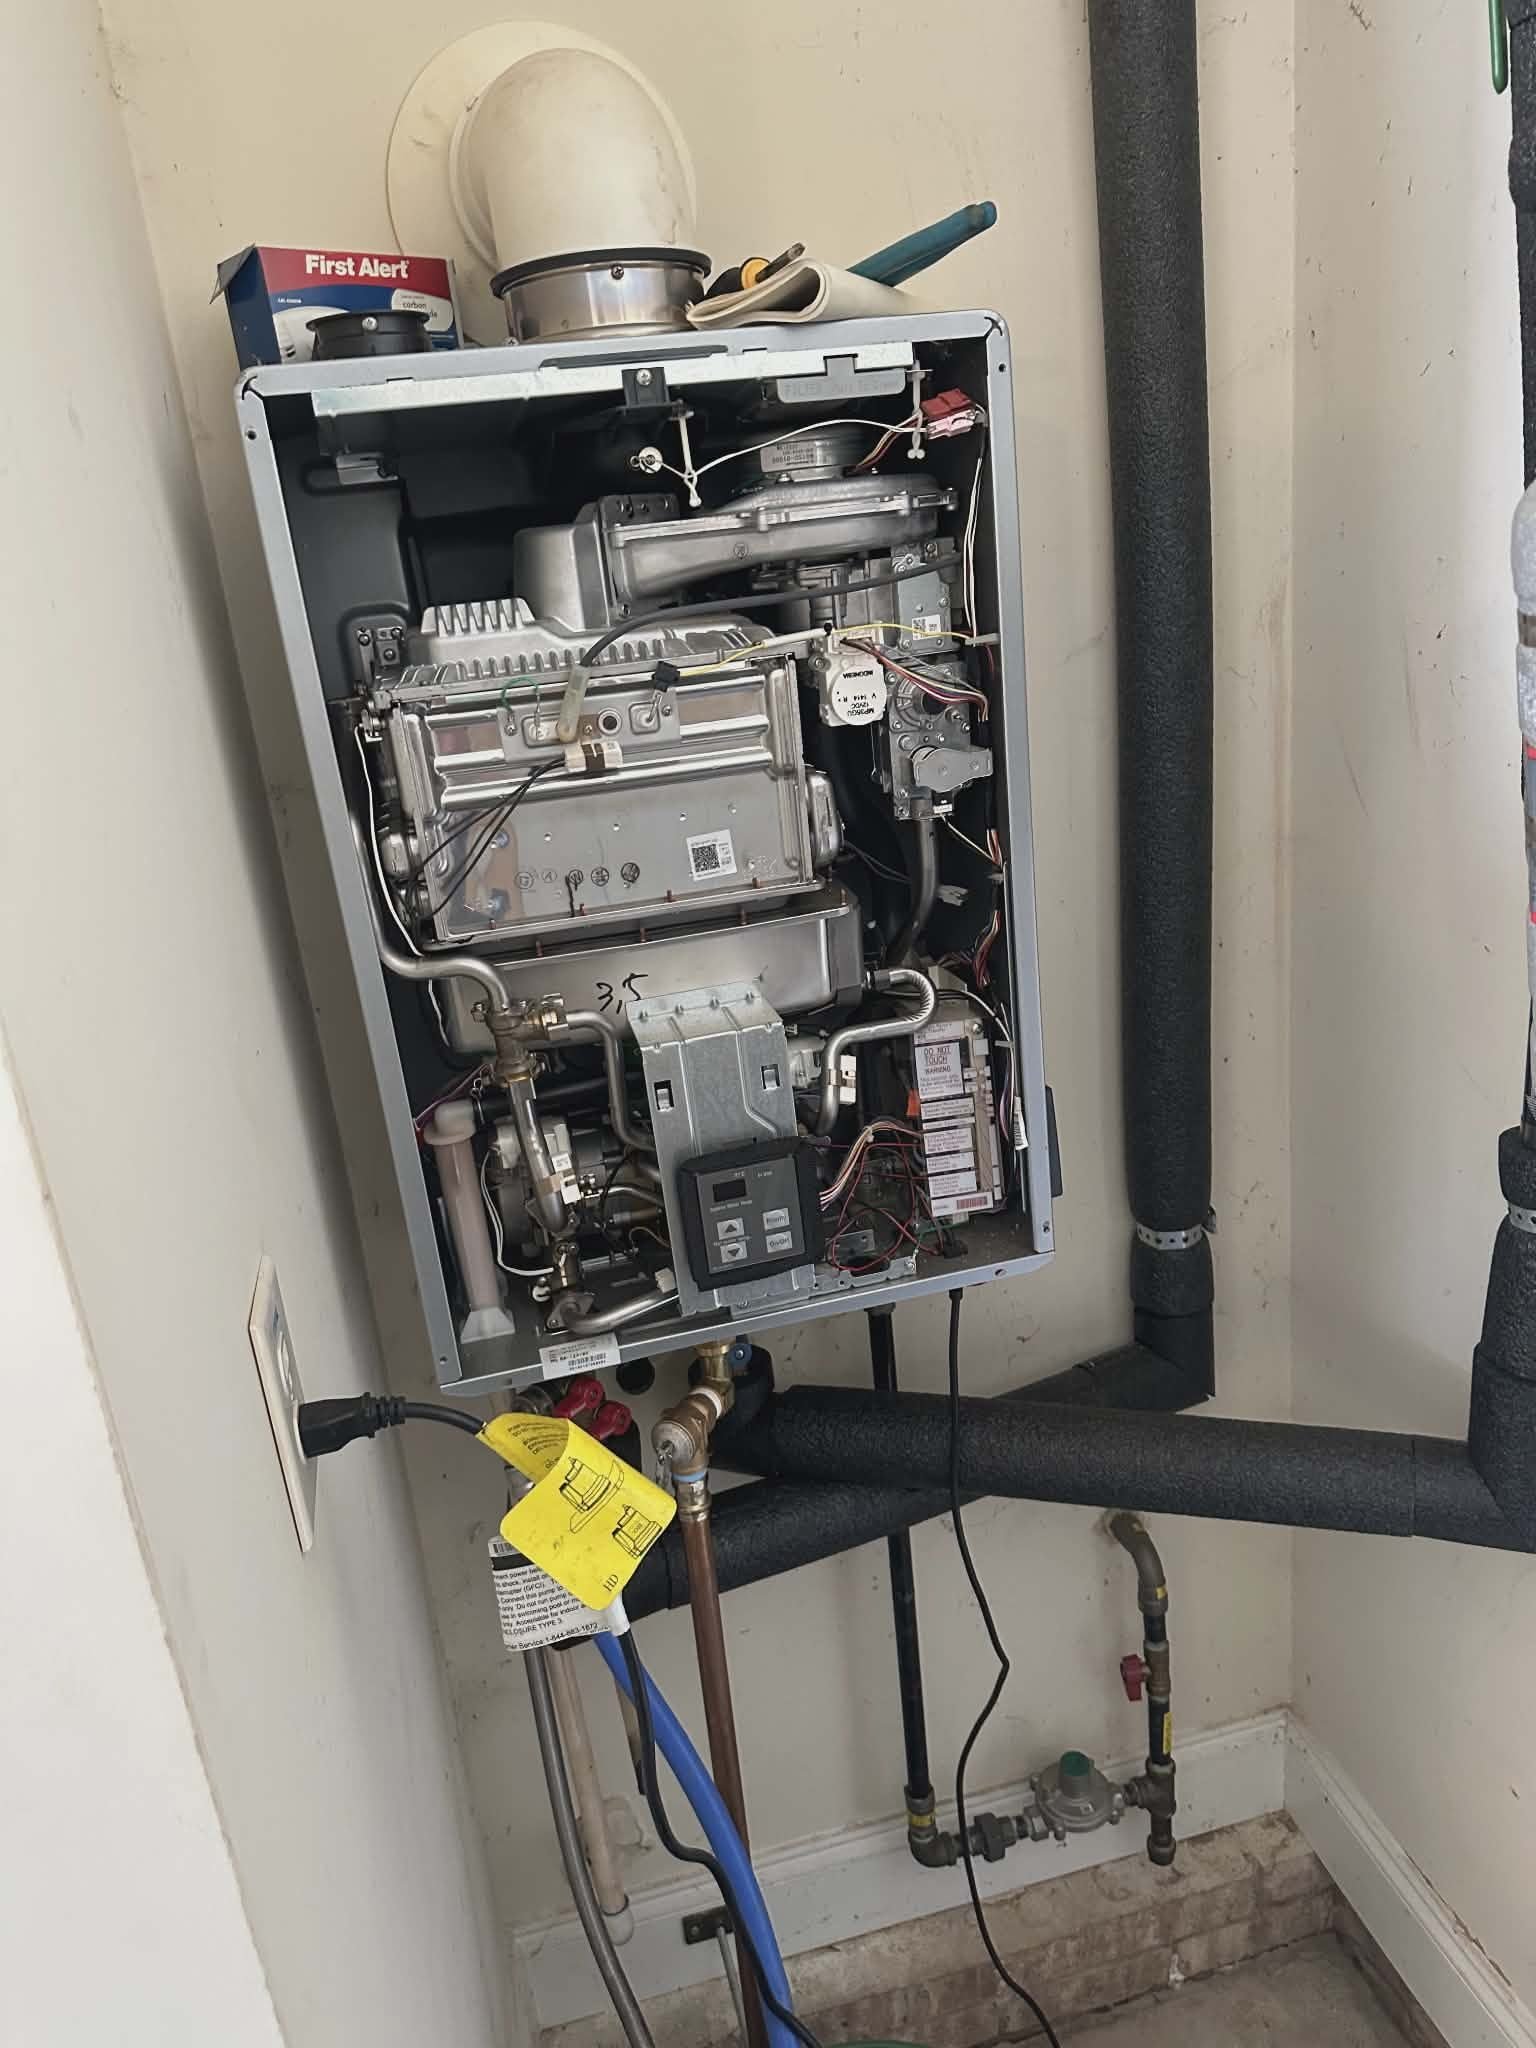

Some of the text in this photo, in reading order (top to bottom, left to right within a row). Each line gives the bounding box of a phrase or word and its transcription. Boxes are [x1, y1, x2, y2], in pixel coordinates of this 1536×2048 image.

[305, 254, 409, 278] First Alert
[603, 1574, 619, 1592] HD
[504, 1624, 537, 1636] CLOSURE
[538, 1619, 555, 1629] TYPE
